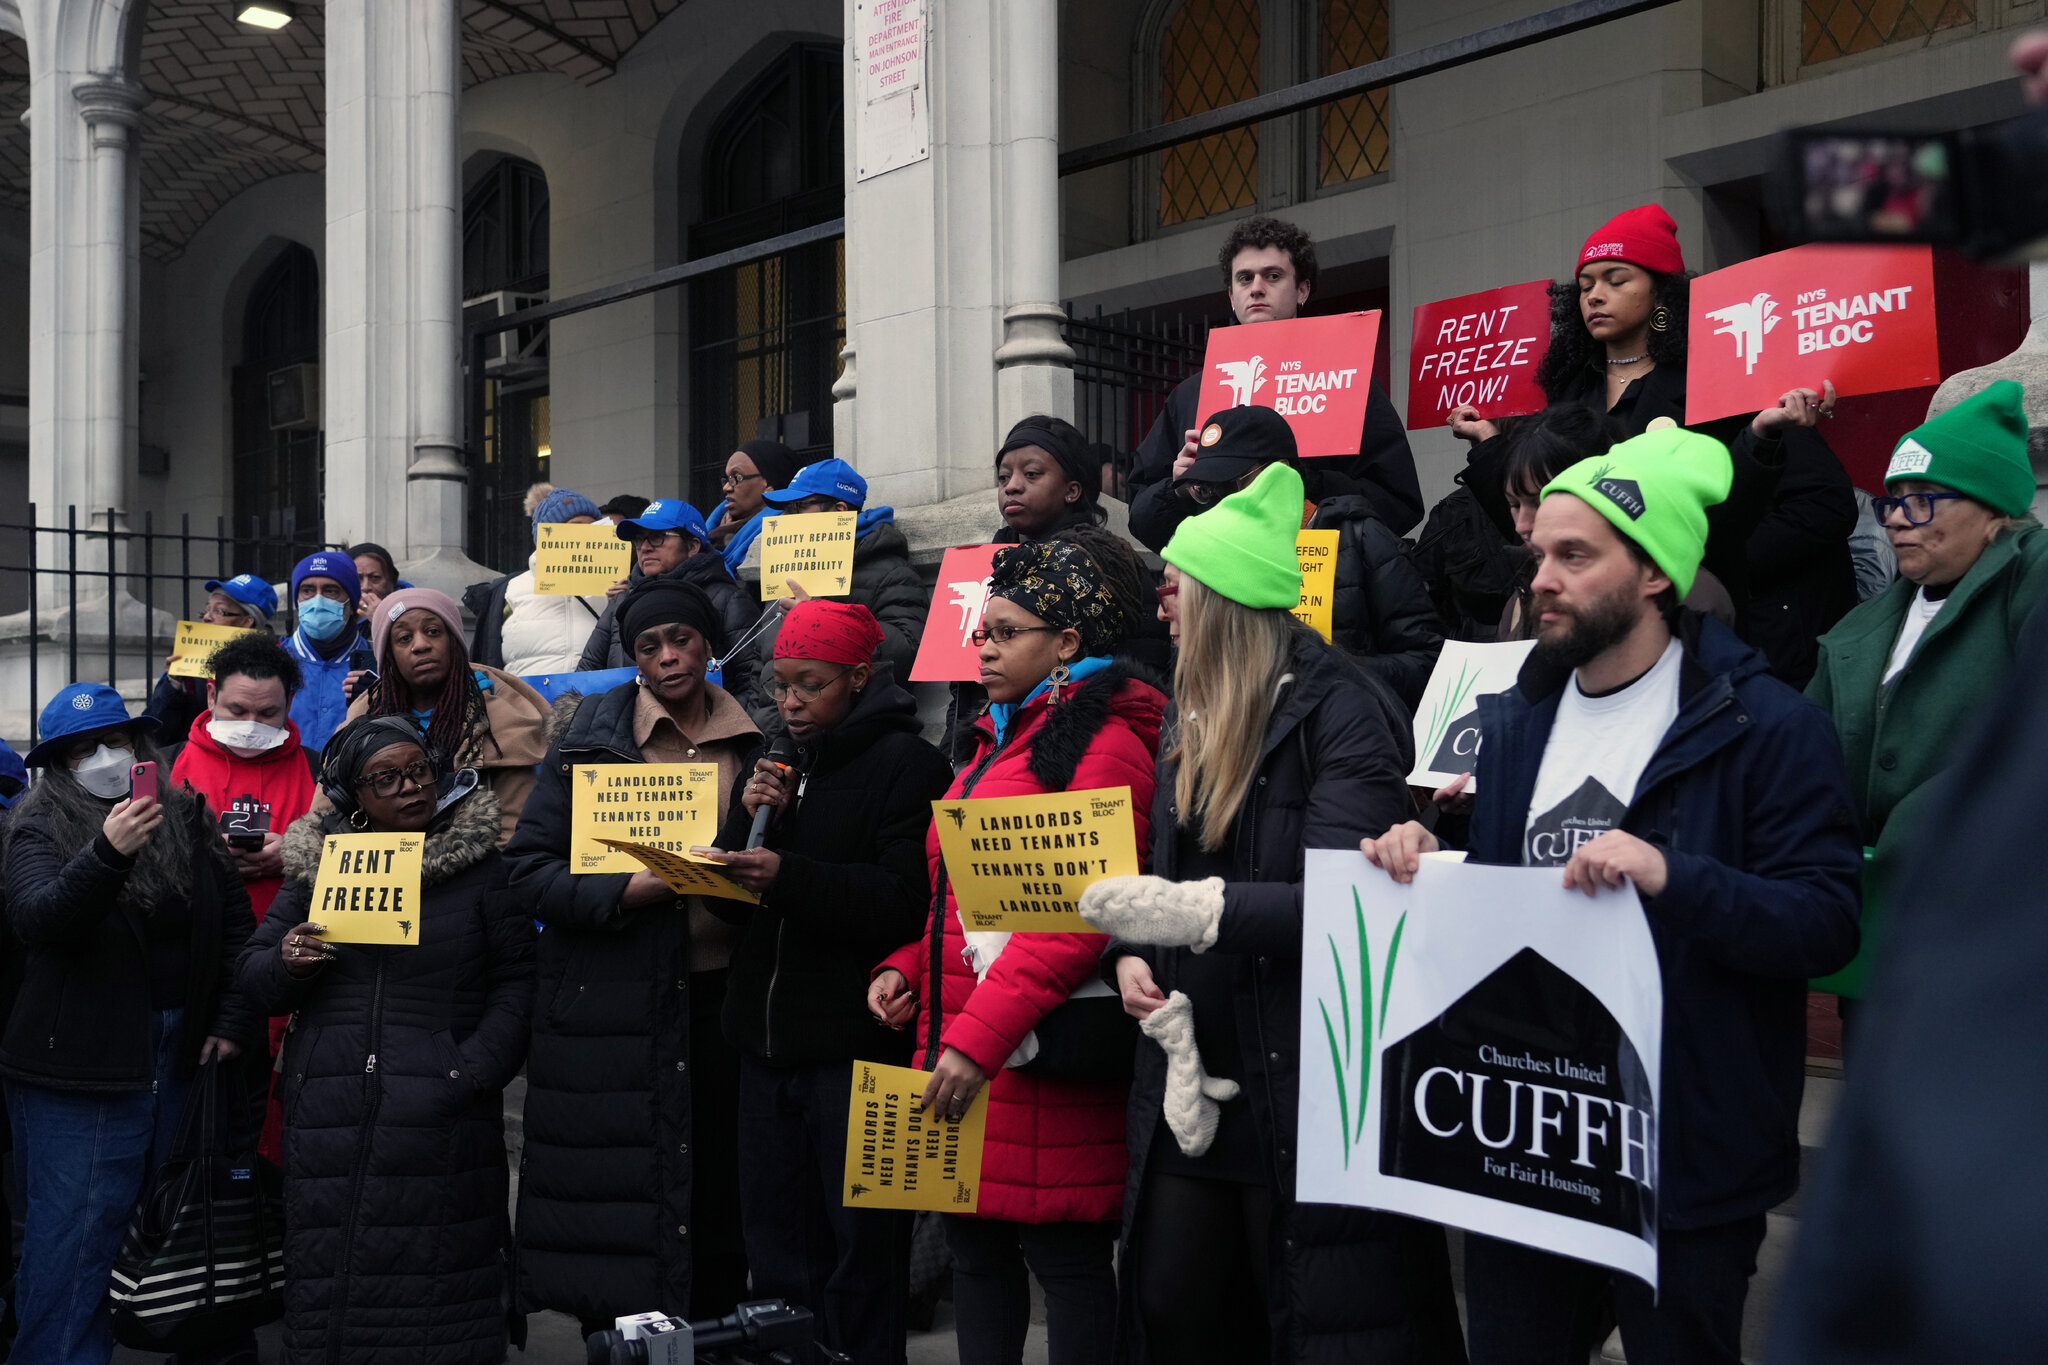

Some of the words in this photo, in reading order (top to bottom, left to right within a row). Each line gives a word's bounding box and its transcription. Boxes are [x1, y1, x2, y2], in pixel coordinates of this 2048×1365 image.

[884, 10, 902, 26] FIRE
[868, 19, 919, 47] DEPARTMENT
[869, 47, 885, 59] MAIN
[885, 33, 918, 53] ENTRANCE
[869, 63, 881, 76] ON
[881, 48, 918, 72] JOHNSON
[880, 69, 906, 88] STREET
[1797, 288, 1826, 305] NYS
[1791, 285, 1912, 330] TENANT
[1436, 305, 1519, 346] RENT
[1798, 320, 1873, 355] BLOC
[1280, 361, 1302, 372] NYS
[1418, 337, 1537, 382] FREEZE
[1274, 368, 1358, 394] TENANT
[1436, 374, 1509, 411] NOW!
[1274, 394, 1328, 416] BLOC
[1601, 481, 1643, 515] CUFFH
[541, 541, 581, 549] QUALITY
[585, 541, 627, 550] REPAIRS
[766, 534, 805, 547] QUALITY
[809, 531, 852, 543] REPAIRS
[571, 554, 594, 562] REAL
[794, 548, 818, 559] REAL
[1297, 546, 1329, 557] EFEND
[545, 565, 620, 575] AFFORDABILITY
[770, 560, 844, 574] AFFORDABILITY
[1299, 562, 1324, 573] IGHT
[1311, 595, 1323, 607] IN
[181, 636, 219, 647] QUALITY
[607, 776, 684, 788] LANDLORDS
[597, 791, 630, 803] NEED
[636, 790, 694, 802] TENANTS
[1090, 800, 1126, 809] TENANT
[592, 811, 651, 823] TENANTS
[657, 810, 698, 821] DON'T
[980, 810, 1083, 831] LANDLORDS
[1092, 809, 1117, 818] BLOC
[629, 826, 662, 837] NEED
[971, 837, 1012, 851] NEED
[1020, 831, 1100, 850] TENANTS
[339, 849, 396, 874] RENT
[971, 862, 1046, 876] TENANTS
[1053, 859, 1108, 876] DON'T
[1022, 882, 1063, 895] NEED
[321, 886, 404, 912] FREEZE
[1478, 1044, 1552, 1074] Churches
[1554, 1057, 1607, 1086] United
[862, 1066, 871, 1093] TENANT
[868, 1076, 877, 1094] BLOC
[882, 1093, 899, 1150] TENANTS
[908, 1092, 923, 1132] DON'T
[1414, 1066, 1653, 1190] CUFFH
[862, 1101, 879, 1176] LANDLORDS
[925, 1130, 940, 1159] NEED
[880, 1157, 895, 1186] NEED
[904, 1139, 921, 1191] TENANTS
[1484, 1156, 1507, 1178] For
[1510, 1162, 1538, 1185] Fair
[1541, 1169, 1600, 1205] Housing
[956, 1181, 965, 1204] TENANT
[963, 1188, 971, 1203] BLOC
